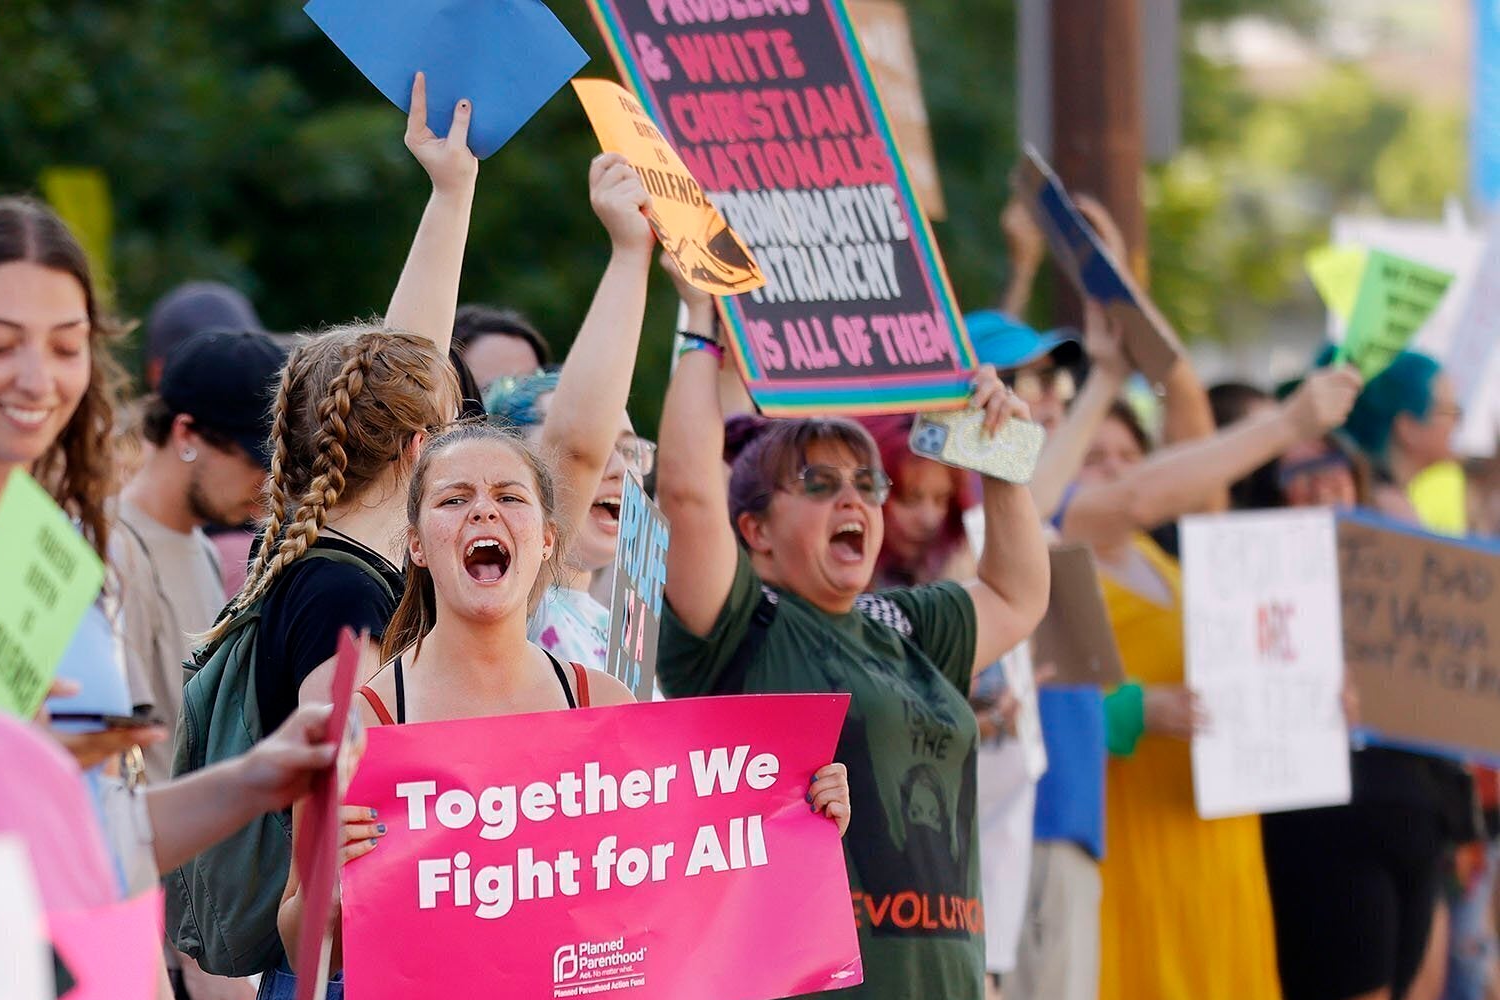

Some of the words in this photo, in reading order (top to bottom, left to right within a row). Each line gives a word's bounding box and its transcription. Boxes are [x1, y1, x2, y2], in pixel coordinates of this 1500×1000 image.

[665, 28, 806, 83] WHITE
[751, 241, 902, 304] ATRIARCHY
[782, 315, 841, 371] ALL
[832, 314, 874, 367] OF
[395, 761, 677, 840] Together
[688, 745, 780, 798] We
[418, 847, 581, 919] Fight
[591, 835, 676, 891] for
[684, 814, 769, 877] All
[579, 936, 624, 956] Planned
[579, 947, 646, 970] Parenthood
[554, 986, 578, 998] Planned
[579, 983, 611, 995] Parenthood
[611, 980, 630, 990] Action
[630, 977, 645, 987] Fund
